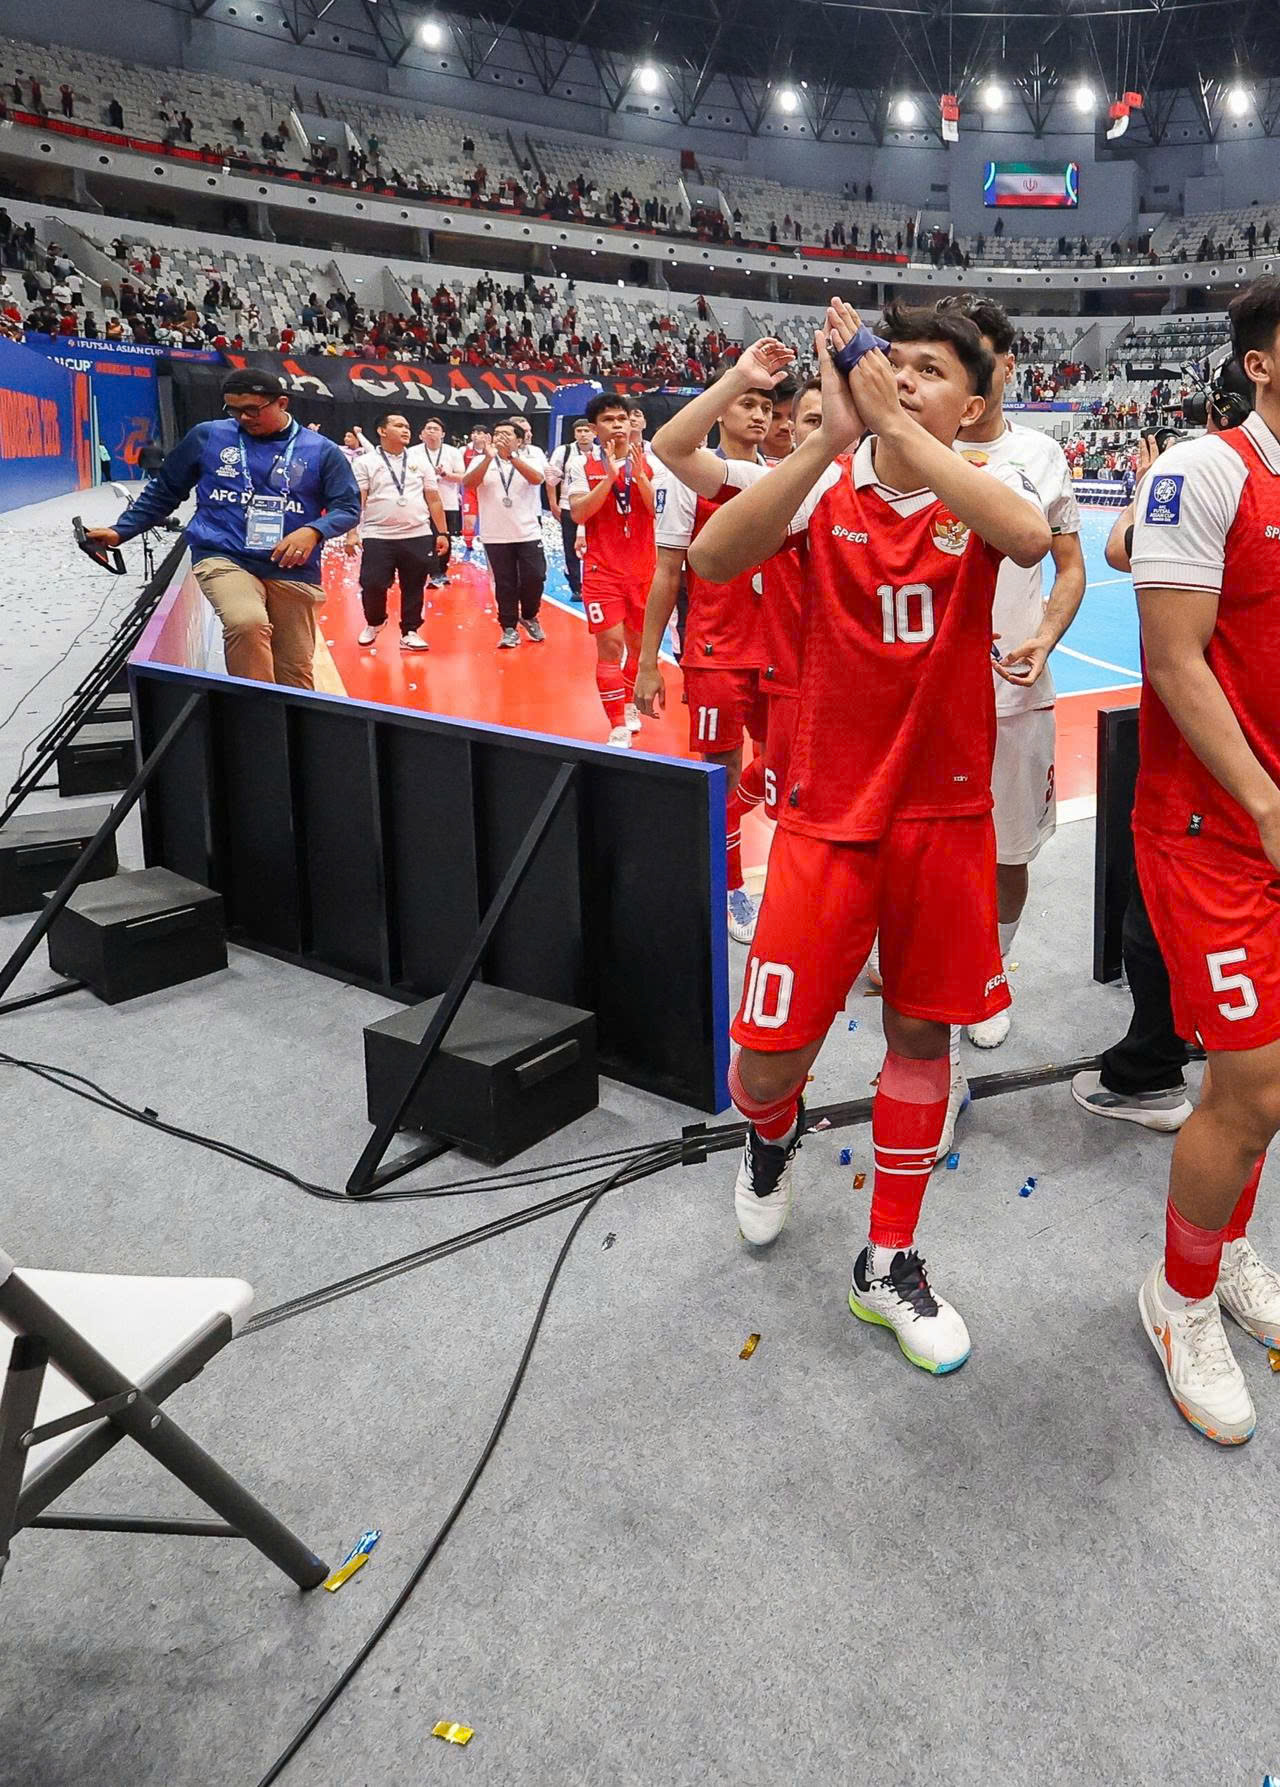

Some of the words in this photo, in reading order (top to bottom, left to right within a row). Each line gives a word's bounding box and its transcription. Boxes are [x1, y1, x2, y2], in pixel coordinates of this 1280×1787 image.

[65, 358, 91, 372] CUP
[81, 341, 114, 352] FUTSAL
[116, 345, 144, 354] ASIAN
[144, 348, 164, 357] CUP
[349, 363, 584, 413] GRAND
[209, 489, 238, 503] AFC
[876, 583, 935, 644] 10
[698, 706, 719, 741] 11
[742, 956, 795, 1029] 10
[1206, 947, 1259, 1022] 5
